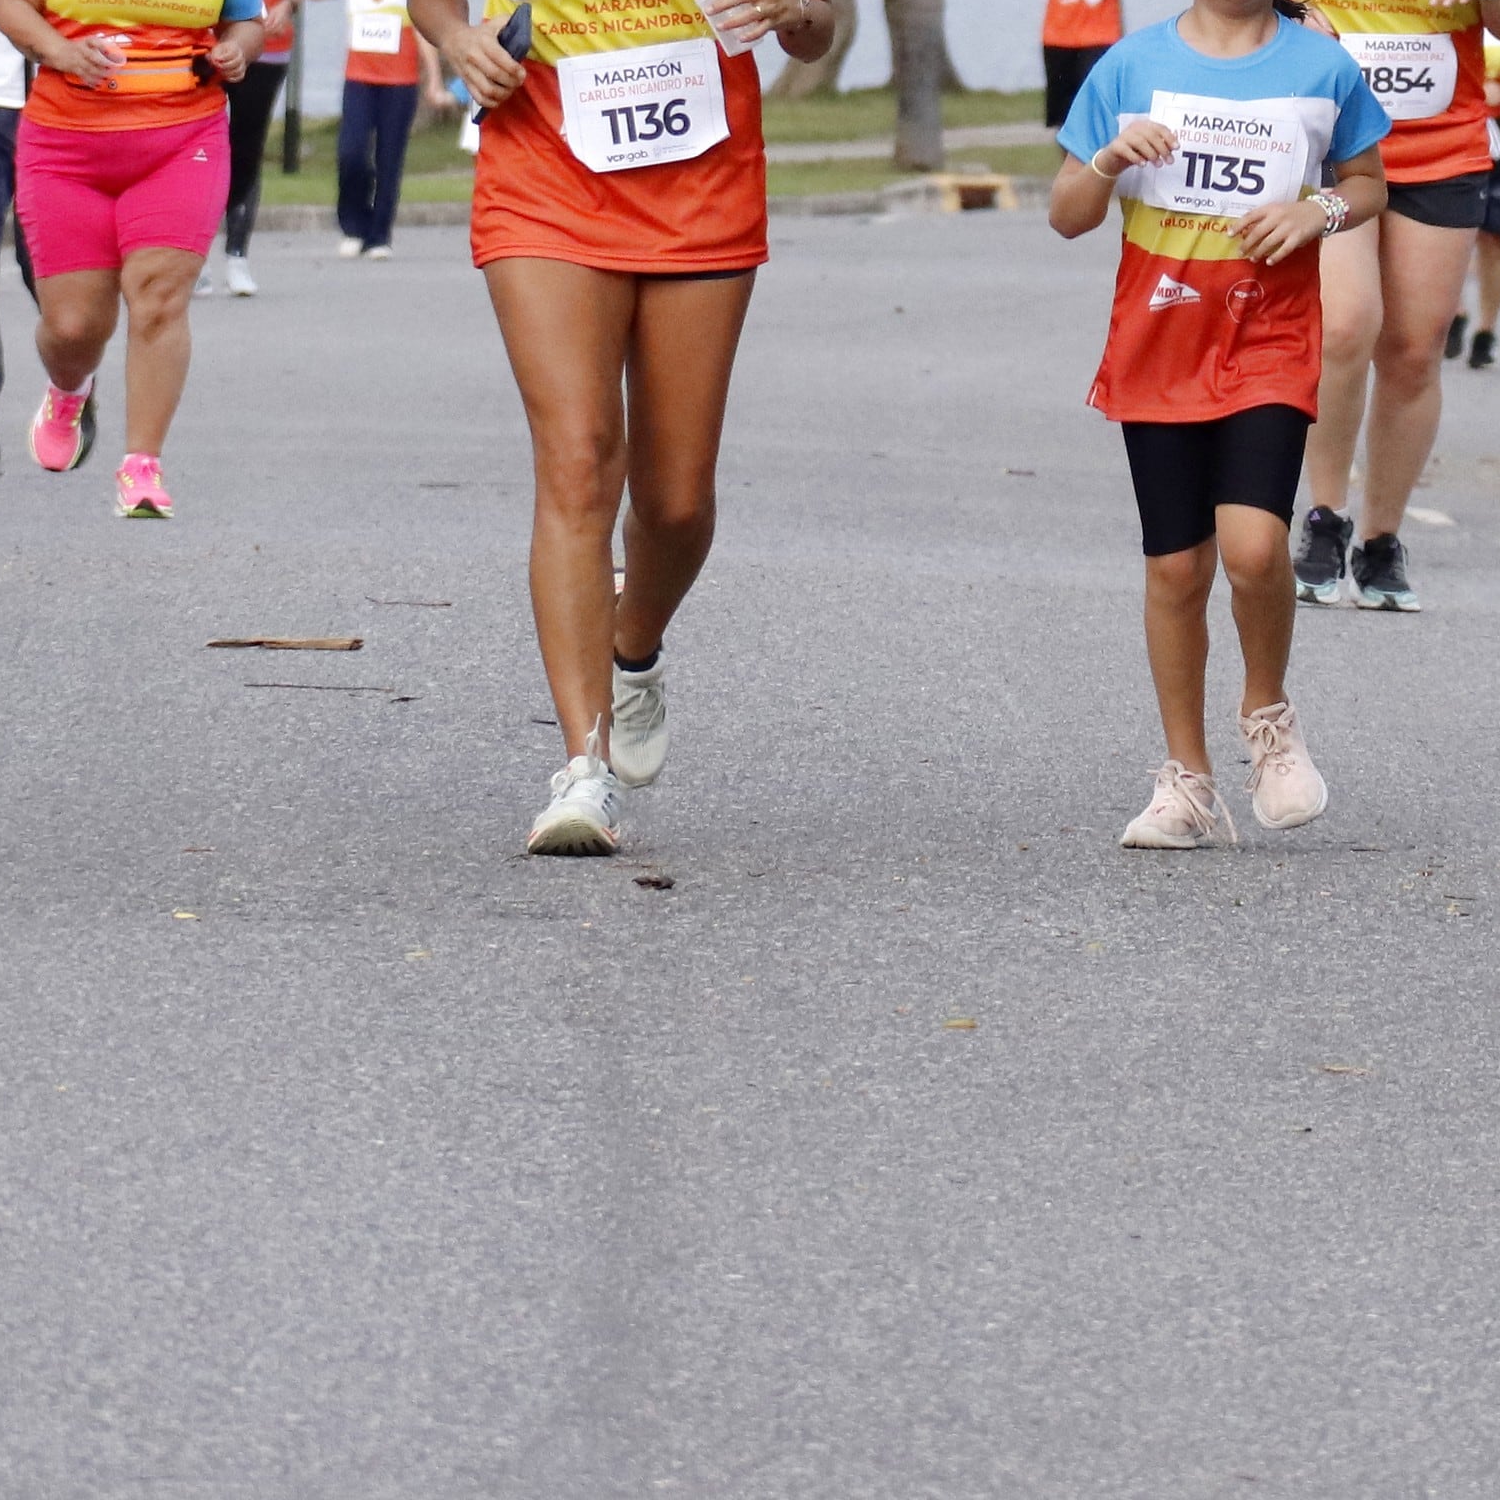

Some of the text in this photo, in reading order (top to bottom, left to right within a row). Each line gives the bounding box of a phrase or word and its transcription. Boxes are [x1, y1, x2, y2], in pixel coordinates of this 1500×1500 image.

[538, 21, 597, 36] CARLOS
[603, 12, 694, 34] NICANDRO
[594, 61, 683, 87] MARATÓN
[1361, 66, 1436, 94] 1854
[579, 74, 706, 104] CARLOS NICANDRO PAZ
[601, 98, 691, 146] 1136
[1182, 113, 1273, 138] MARATÓN
[1173, 128, 1293, 155] ARLOS NICANDRO PAZ
[1182, 150, 1267, 196] 1135
